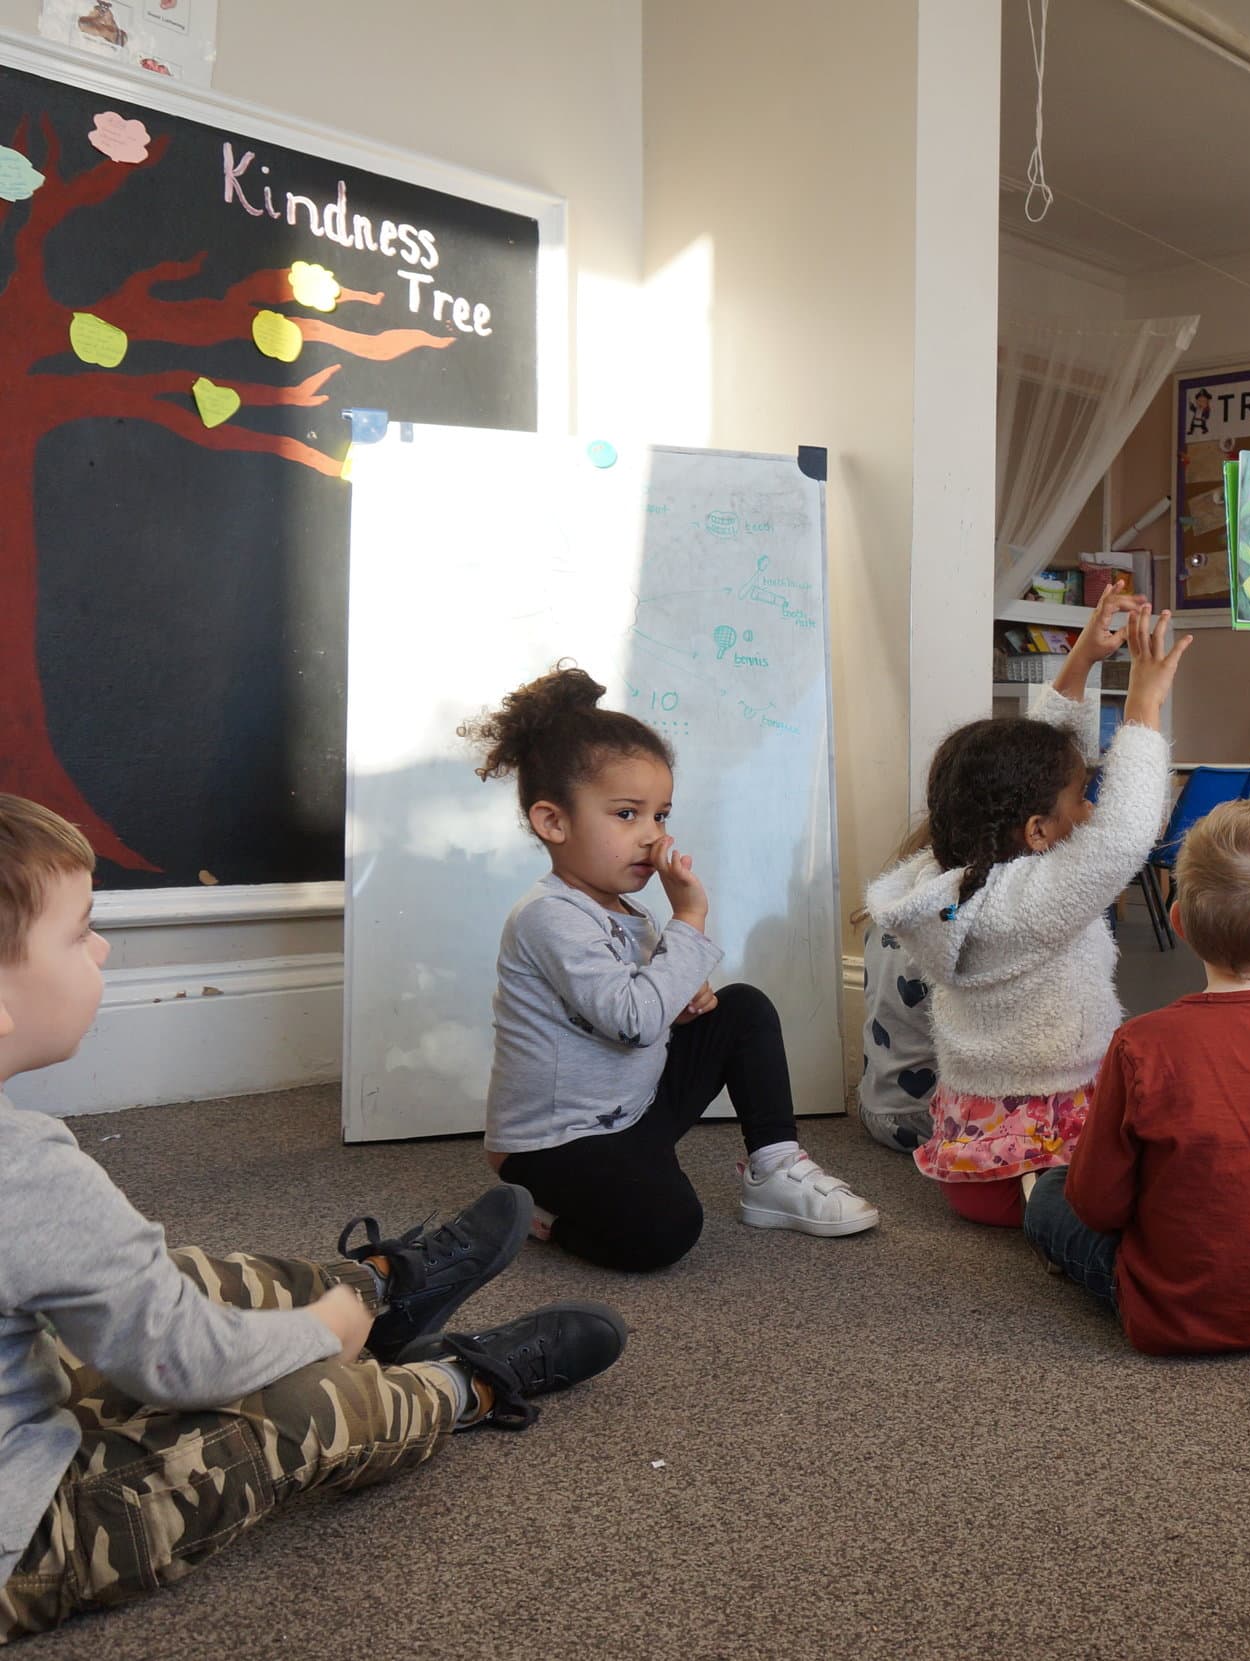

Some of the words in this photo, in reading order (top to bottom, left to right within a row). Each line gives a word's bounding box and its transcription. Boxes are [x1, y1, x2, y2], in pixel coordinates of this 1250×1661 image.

[222, 142, 440, 270] Kindness
[397, 269, 493, 337] Tree
[649, 689, 681, 713] 10
